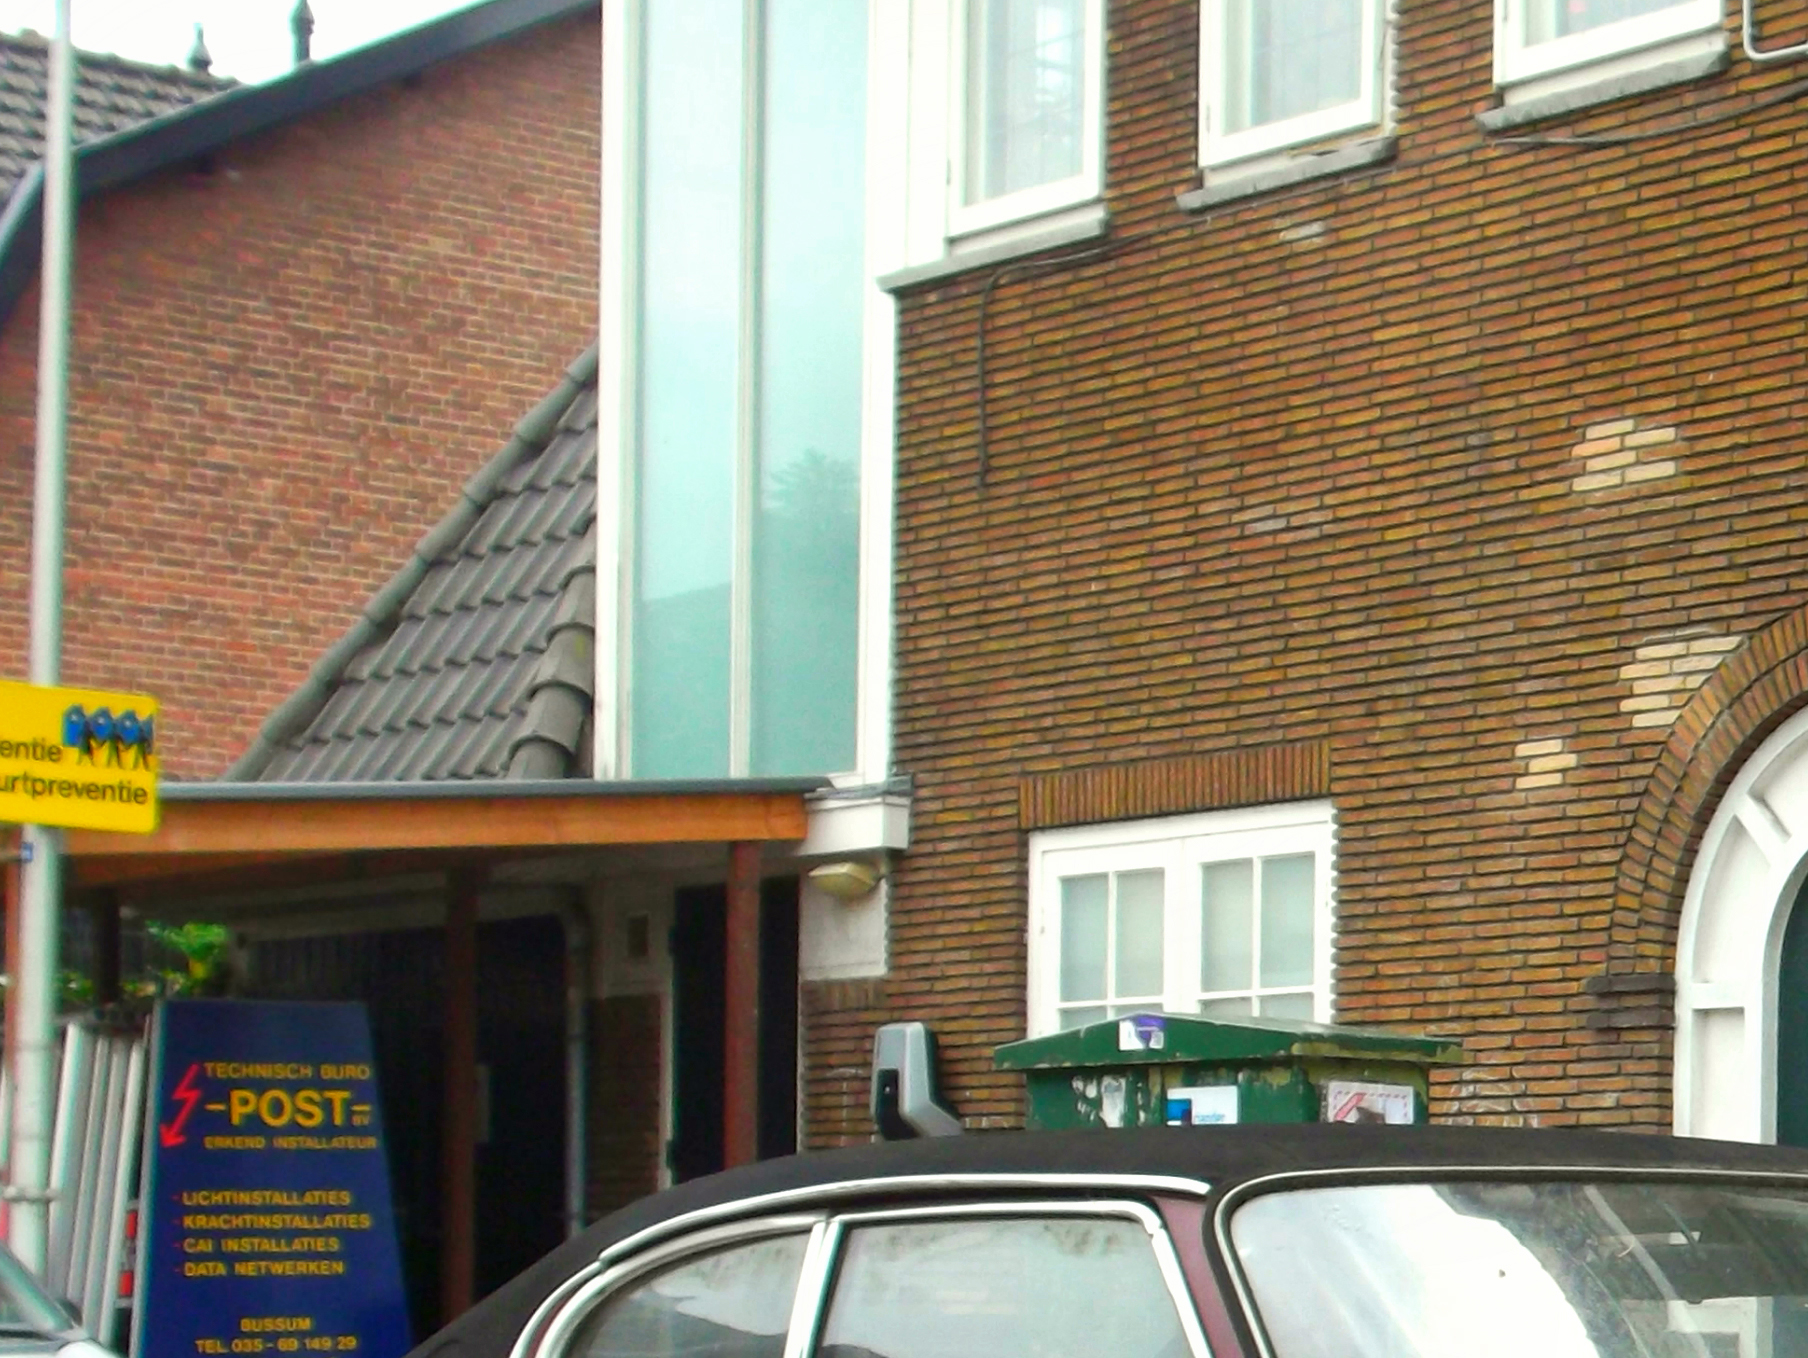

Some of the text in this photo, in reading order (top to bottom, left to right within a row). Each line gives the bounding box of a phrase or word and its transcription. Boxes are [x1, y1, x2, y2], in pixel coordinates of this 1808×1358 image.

[204, 1062, 371, 1080] TECHNISCH BURO
[204, 1136, 377, 1149] ERKEND INSTALLATEUR
[182, 1190, 351, 1206] LICHTINSTALLATIES
[183, 1213, 371, 1229] KRACHTINSTALLATIES
[183, 1236, 339, 1253] CAI INSTALLATIES
[184, 1260, 344, 1277] DATA NETWERKEN
[240, 1317, 311, 1332] BUSSUM
